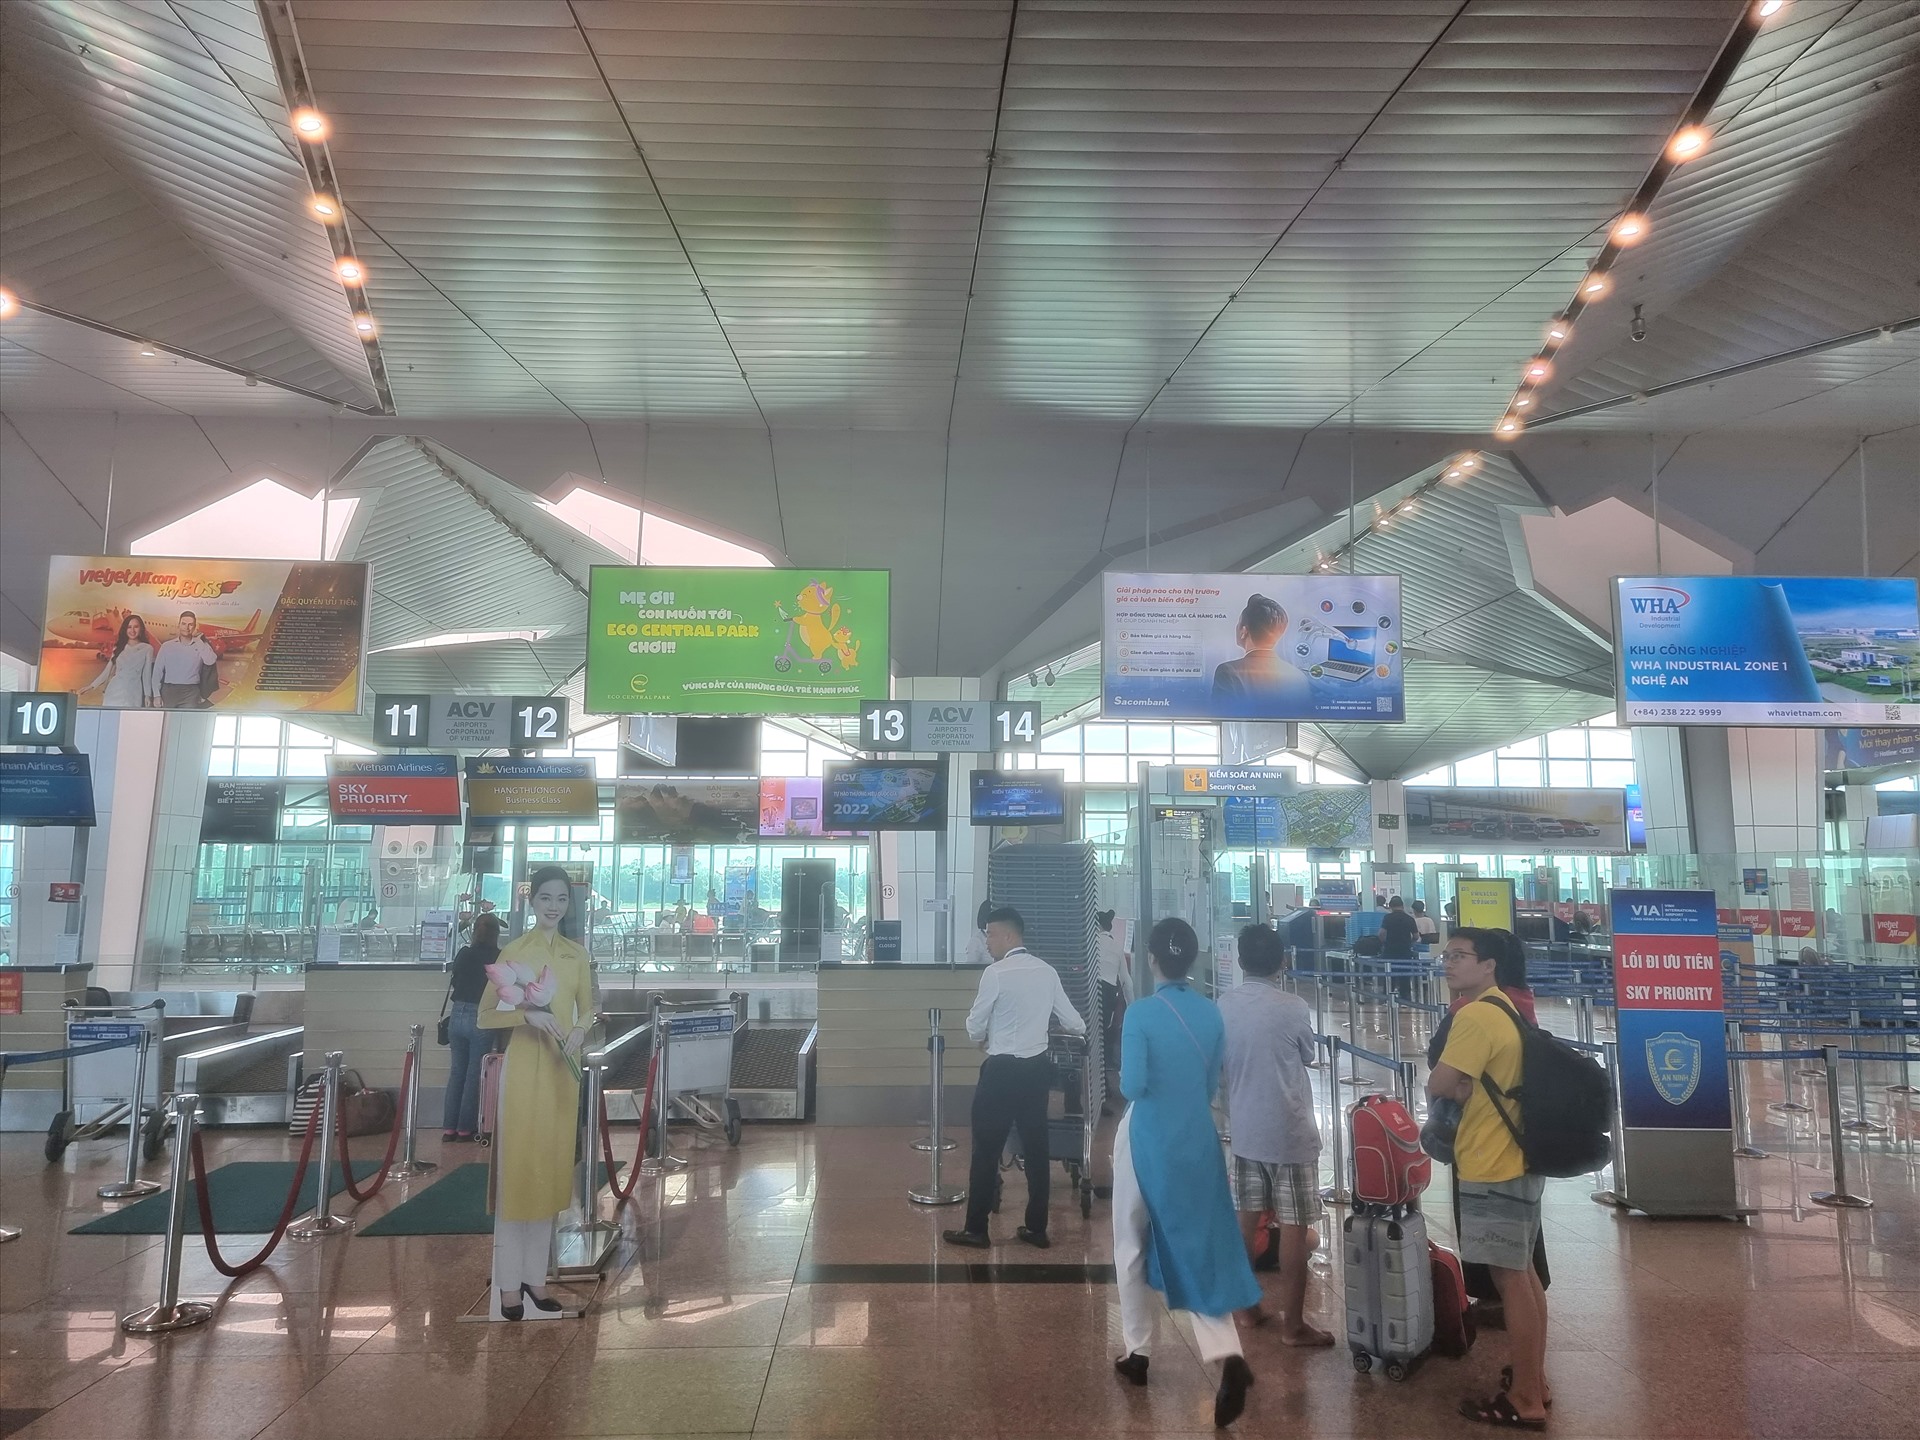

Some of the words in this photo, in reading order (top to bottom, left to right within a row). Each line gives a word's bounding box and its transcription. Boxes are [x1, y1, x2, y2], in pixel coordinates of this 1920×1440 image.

[1116, 586, 1131, 594] Giải
[1195, 588, 1220, 596] trường
[620, 591, 646, 608] MẸ
[1116, 596, 1128, 604] giá
[1158, 595, 1174, 603] biến
[1631, 598, 1680, 614] WHA
[638, 609, 664, 619] CON
[666, 606, 706, 619] MUỐN
[708, 609, 731, 620] TỚI
[607, 624, 638, 636] ECO
[641, 624, 714, 637] CENTRAL
[717, 625, 759, 637] PARK
[628, 641, 676, 653] CHƠI!!
[1630, 646, 1656, 655] KHU
[1660, 643, 1696, 655] CÔNG
[1700, 644, 1746, 657] NGHIỆP
[1631, 661, 1662, 671] WHA
[1665, 661, 1740, 671] INDUSTRIAL
[1744, 662, 1779, 671] ZONE
[1782, 662, 1787, 671] 1
[1632, 674, 1666, 688] NGHỆ
[1671, 676, 1688, 686] AN
[683, 682, 707, 691] VÙNG
[709, 680, 725, 689] ĐẤT
[727, 680, 744, 689] CỦA
[745, 682, 775, 691] NHỮNG
[776, 683, 794, 692] ĐỨA
[796, 684, 812, 693] TRẺ
[813, 686, 836, 696] HẠNH
[837, 684, 859, 694] PHÚC
[1114, 696, 1170, 707] Sacombank
[447, 702, 496, 718] ACV
[928, 708, 973, 722] ACV
[1633, 708, 1658, 717] (+84)
[1661, 708, 1677, 716] 238
[1680, 708, 1696, 716] 222
[1699, 708, 1722, 716] 9999
[1768, 709, 1842, 717] whavietnam.com
[17, 702, 58, 735] 10
[386, 704, 418, 736] 11
[518, 706, 558, 738] 12
[867, 710, 905, 741] 13
[997, 711, 1034, 742] 14
[356, 763, 396, 772] Vietnam
[397, 763, 432, 772] Airlines
[496, 765, 536, 774] Vietnam
[537, 765, 572, 774] Airlines
[834, 774, 857, 782] ACV
[1209, 769, 1228, 779] KIỂM
[1230, 770, 1248, 778] SOÁT
[1263, 771, 1282, 779] NINH
[339, 784, 368, 793] SKY
[494, 787, 518, 795] HẠNG
[520, 786, 556, 794] THƯƠNG
[1209, 783, 1235, 792] Security
[1237, 783, 1256, 791] Check
[217, 796, 234, 804] BIẾT
[340, 795, 408, 804] PRIORITY
[834, 804, 869, 815] 2022
[1339, 850, 1347, 860] 4
[9, 887, 18, 896] 10
[883, 887, 893, 896] 13
[1631, 905, 1660, 916] VIA
[1622, 950, 1642, 969] LỐI
[1646, 954, 1659, 969] ĐI
[1663, 954, 1680, 969] ƯU
[1684, 952, 1713, 970] TIÊN
[1626, 985, 1650, 999] SKY
[1655, 986, 1713, 1001] PRIORITY
